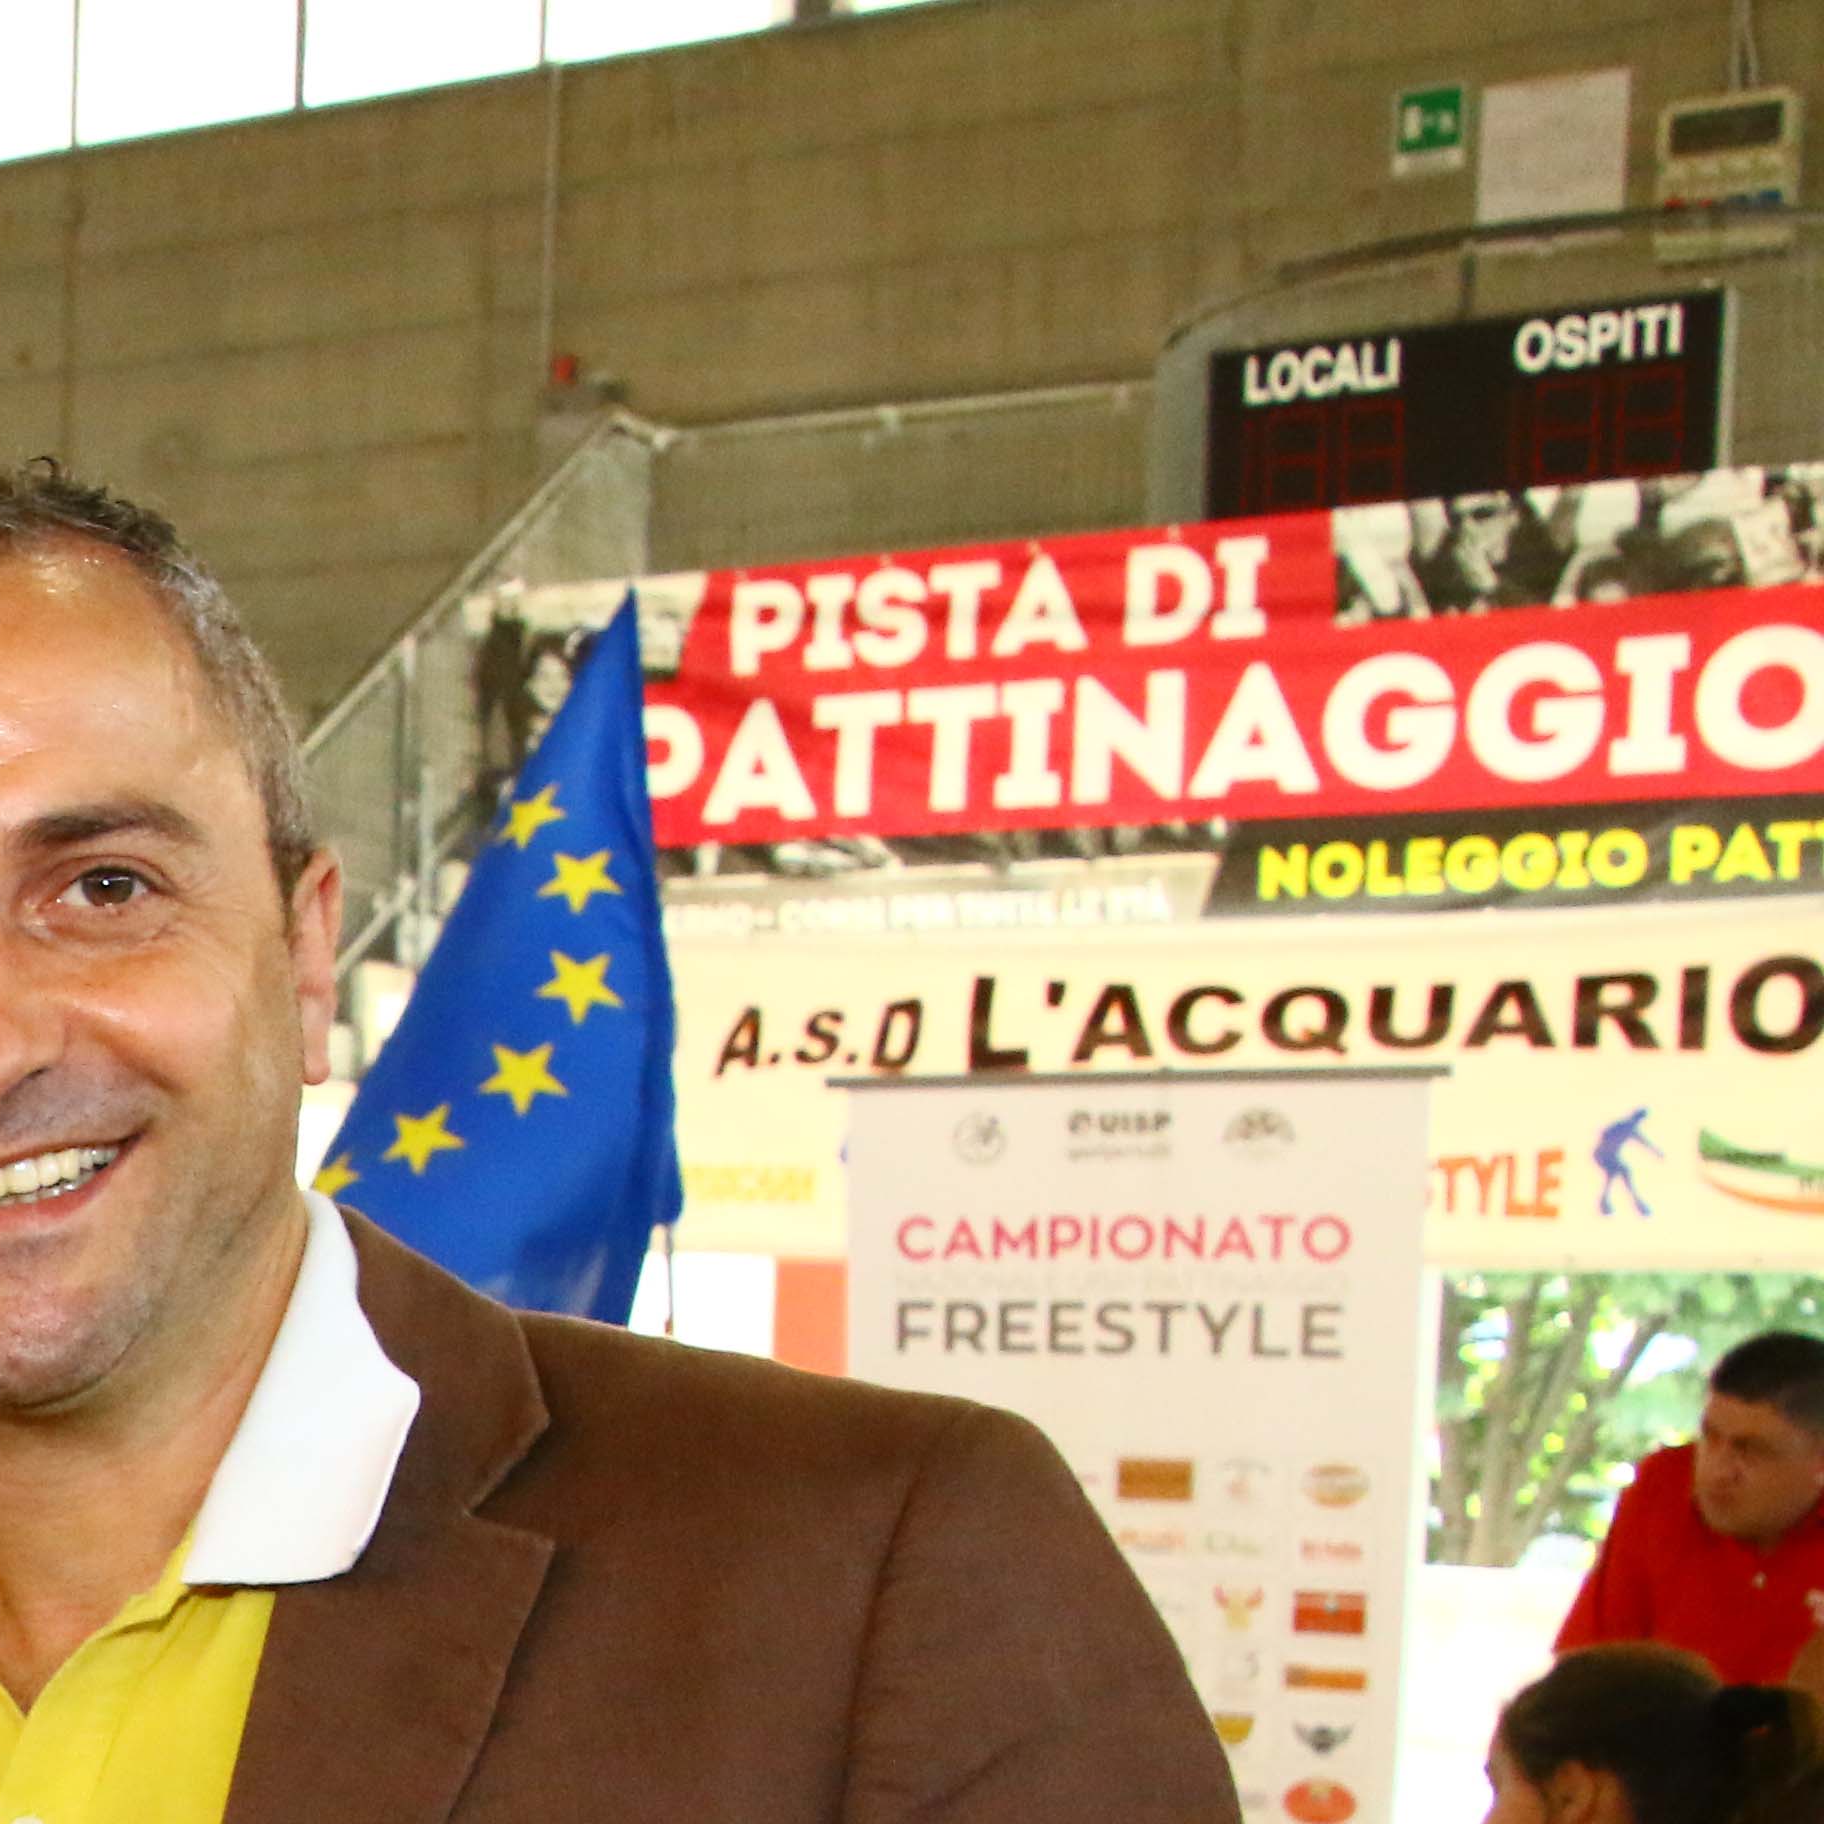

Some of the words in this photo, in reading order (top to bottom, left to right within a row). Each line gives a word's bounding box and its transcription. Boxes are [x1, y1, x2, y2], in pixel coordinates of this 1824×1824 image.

[1243, 338, 1403, 406] LOCALI
[1513, 303, 1685, 374] OSPITI
[729, 554, 1089, 677] PISTA
[1122, 535, 1270, 648] DI
[1256, 828, 1649, 902] NOLEGGIO
[968, 954, 1824, 1074] L'ACQUARIO
[1426, 1148, 1566, 1219] TYLE
[895, 1214, 1353, 1263] CAMPIONATO
[895, 1301, 1345, 1358] FREESTYLE
